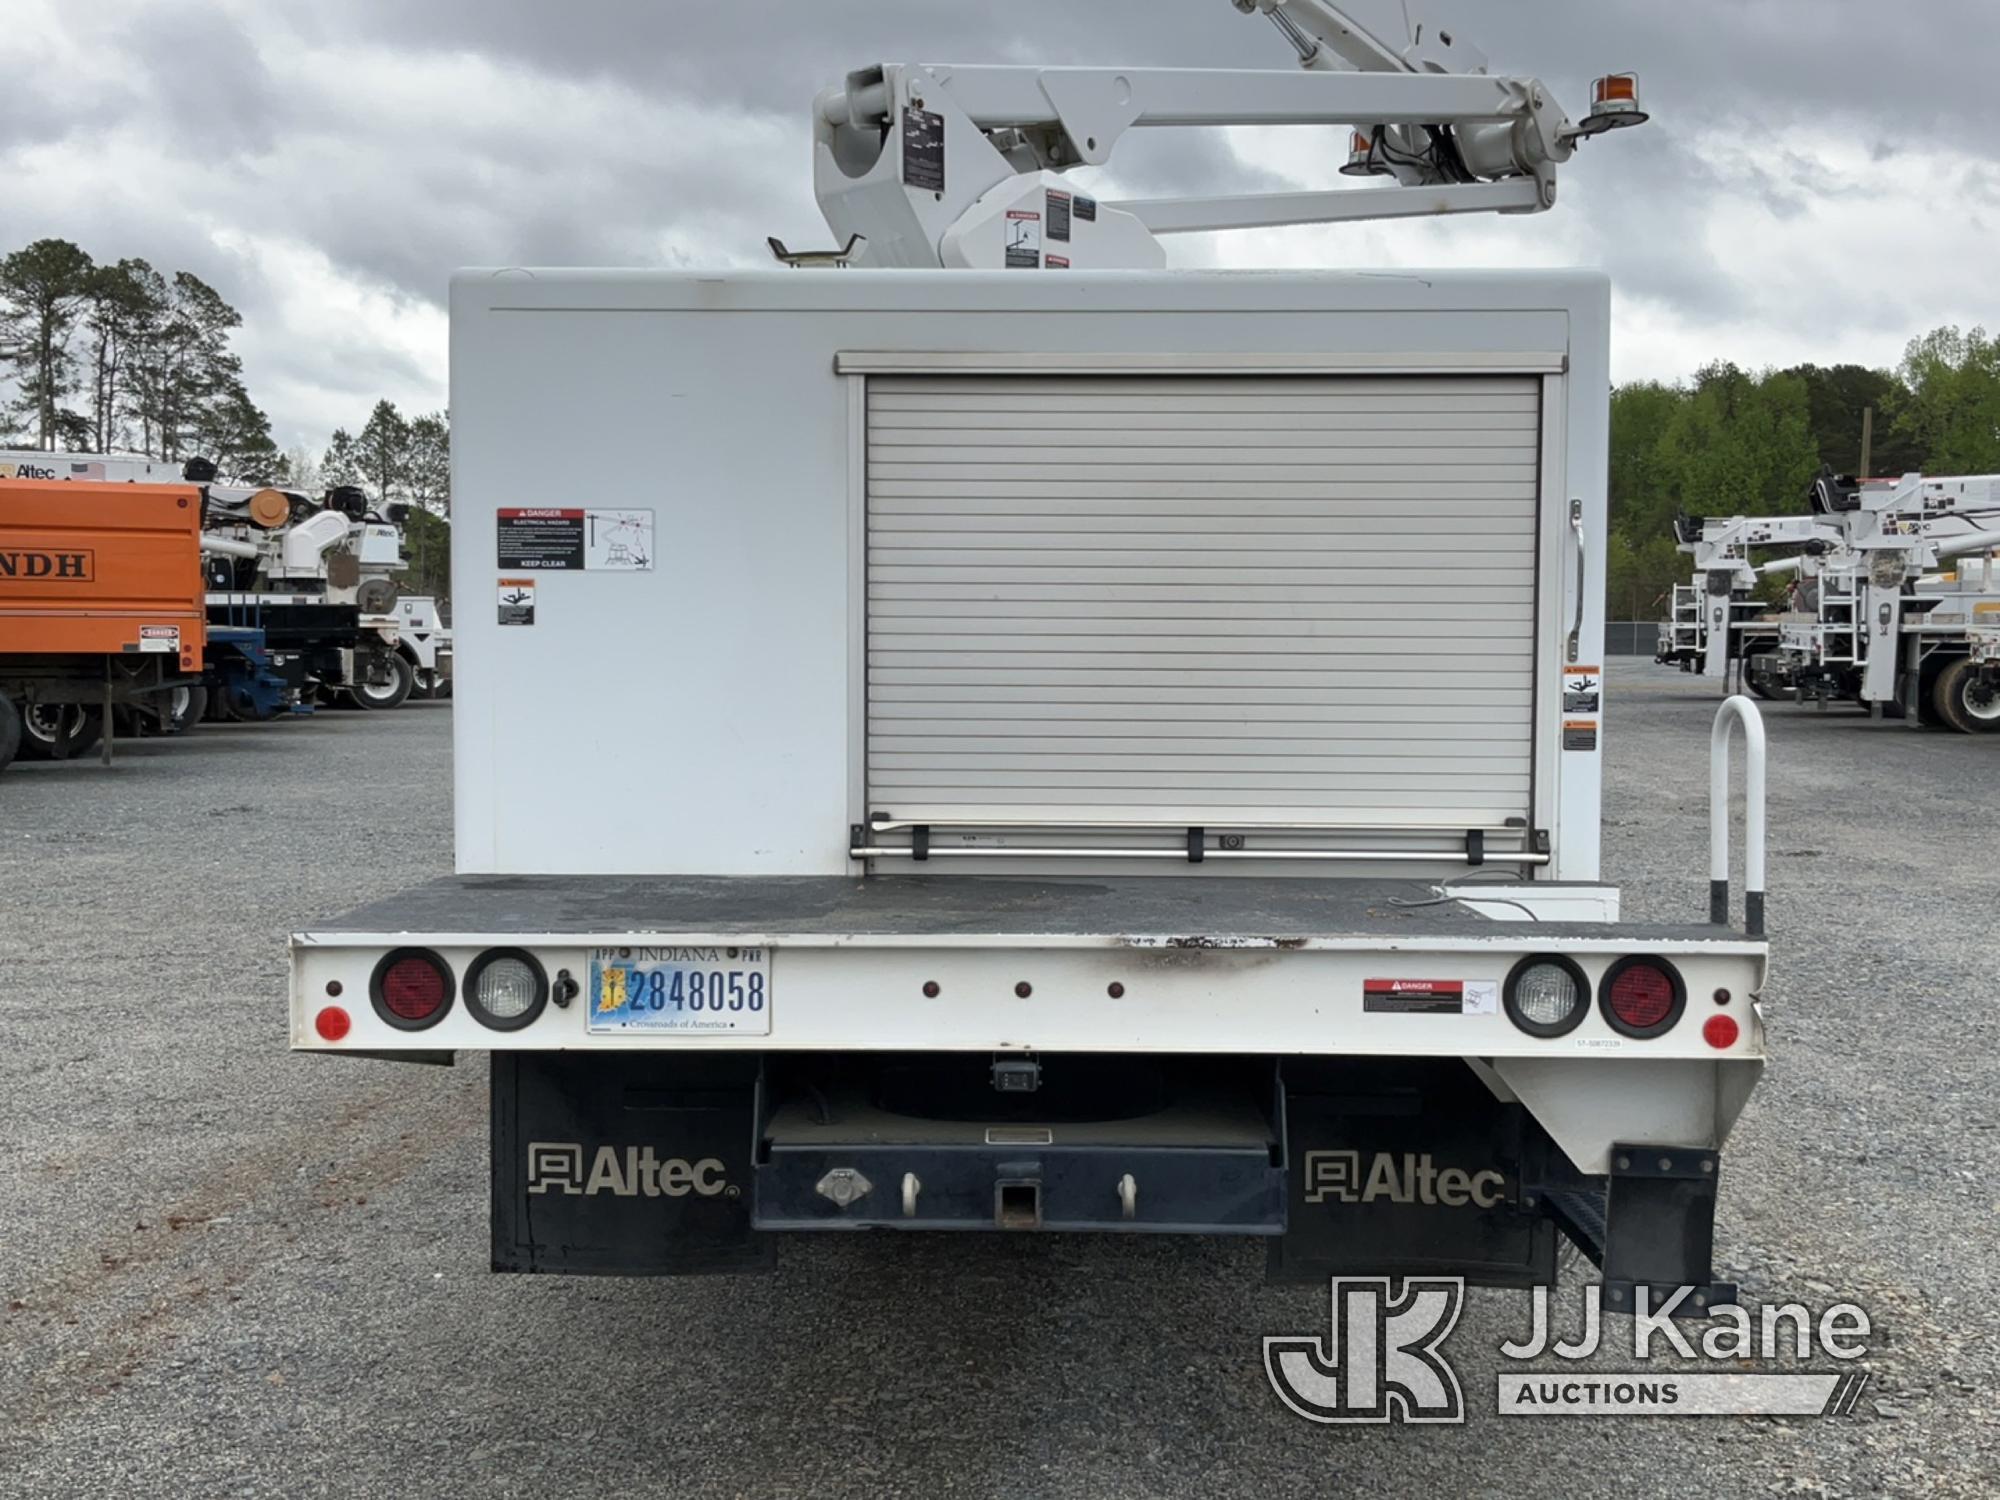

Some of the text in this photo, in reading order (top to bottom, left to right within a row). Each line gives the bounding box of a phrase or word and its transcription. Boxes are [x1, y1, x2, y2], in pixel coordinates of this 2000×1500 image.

[16, 464, 55, 480] Altec
[526, 509, 562, 518] DANGER
[541, 560, 566, 568] CLEAR
[639, 948, 720, 962] INDIANA
[630, 971, 764, 1012] 2848058
[1401, 982, 1432, 990] DANGER
[630, 1019, 728, 1029] Crossroads of America
[585, 1146, 726, 1197] Altec
[1361, 1152, 1505, 1208] Altec
